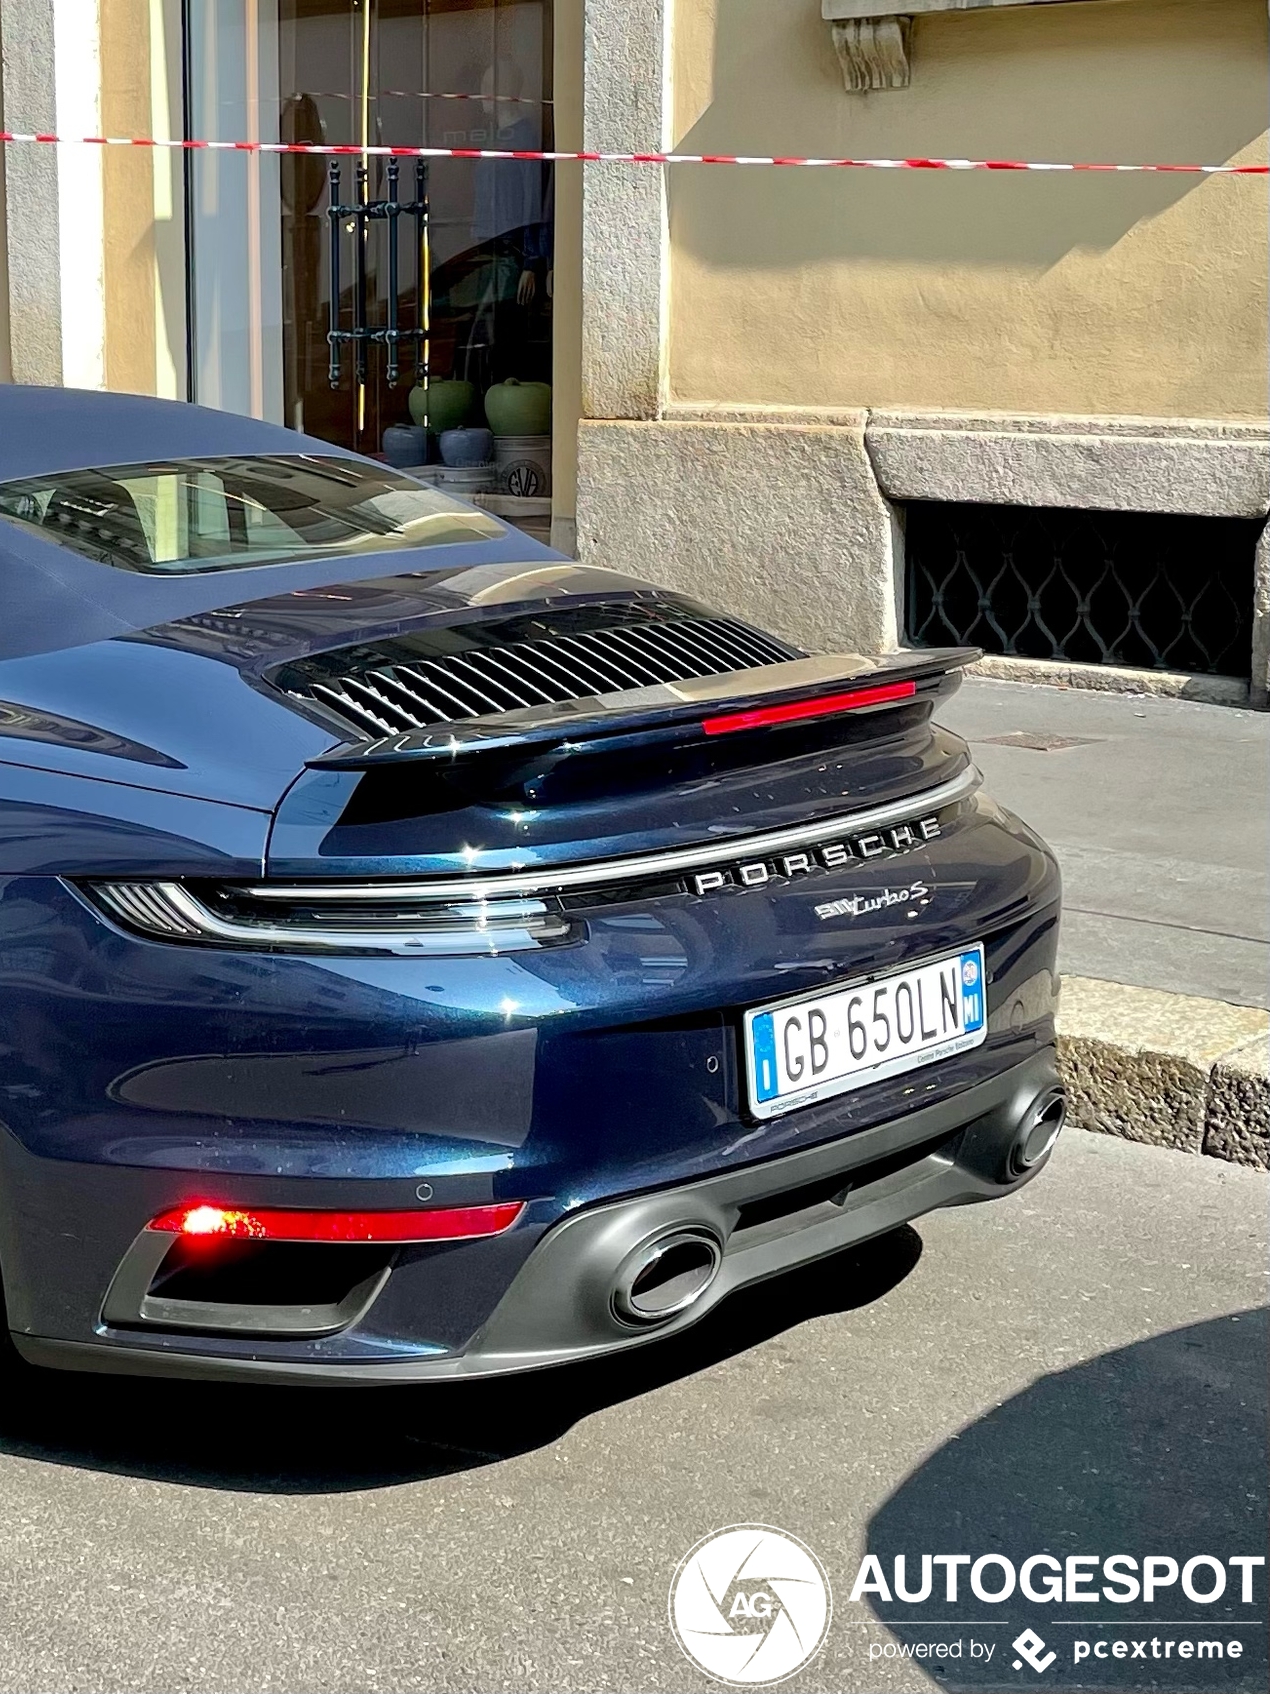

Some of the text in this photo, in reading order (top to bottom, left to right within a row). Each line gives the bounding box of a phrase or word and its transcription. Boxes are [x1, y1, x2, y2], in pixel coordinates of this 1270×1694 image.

[442, 121, 516, 144] malo
[694, 816, 943, 896] PORSCHE
[783, 965, 960, 1083] GB 650LN
[963, 992, 980, 1026] MI
